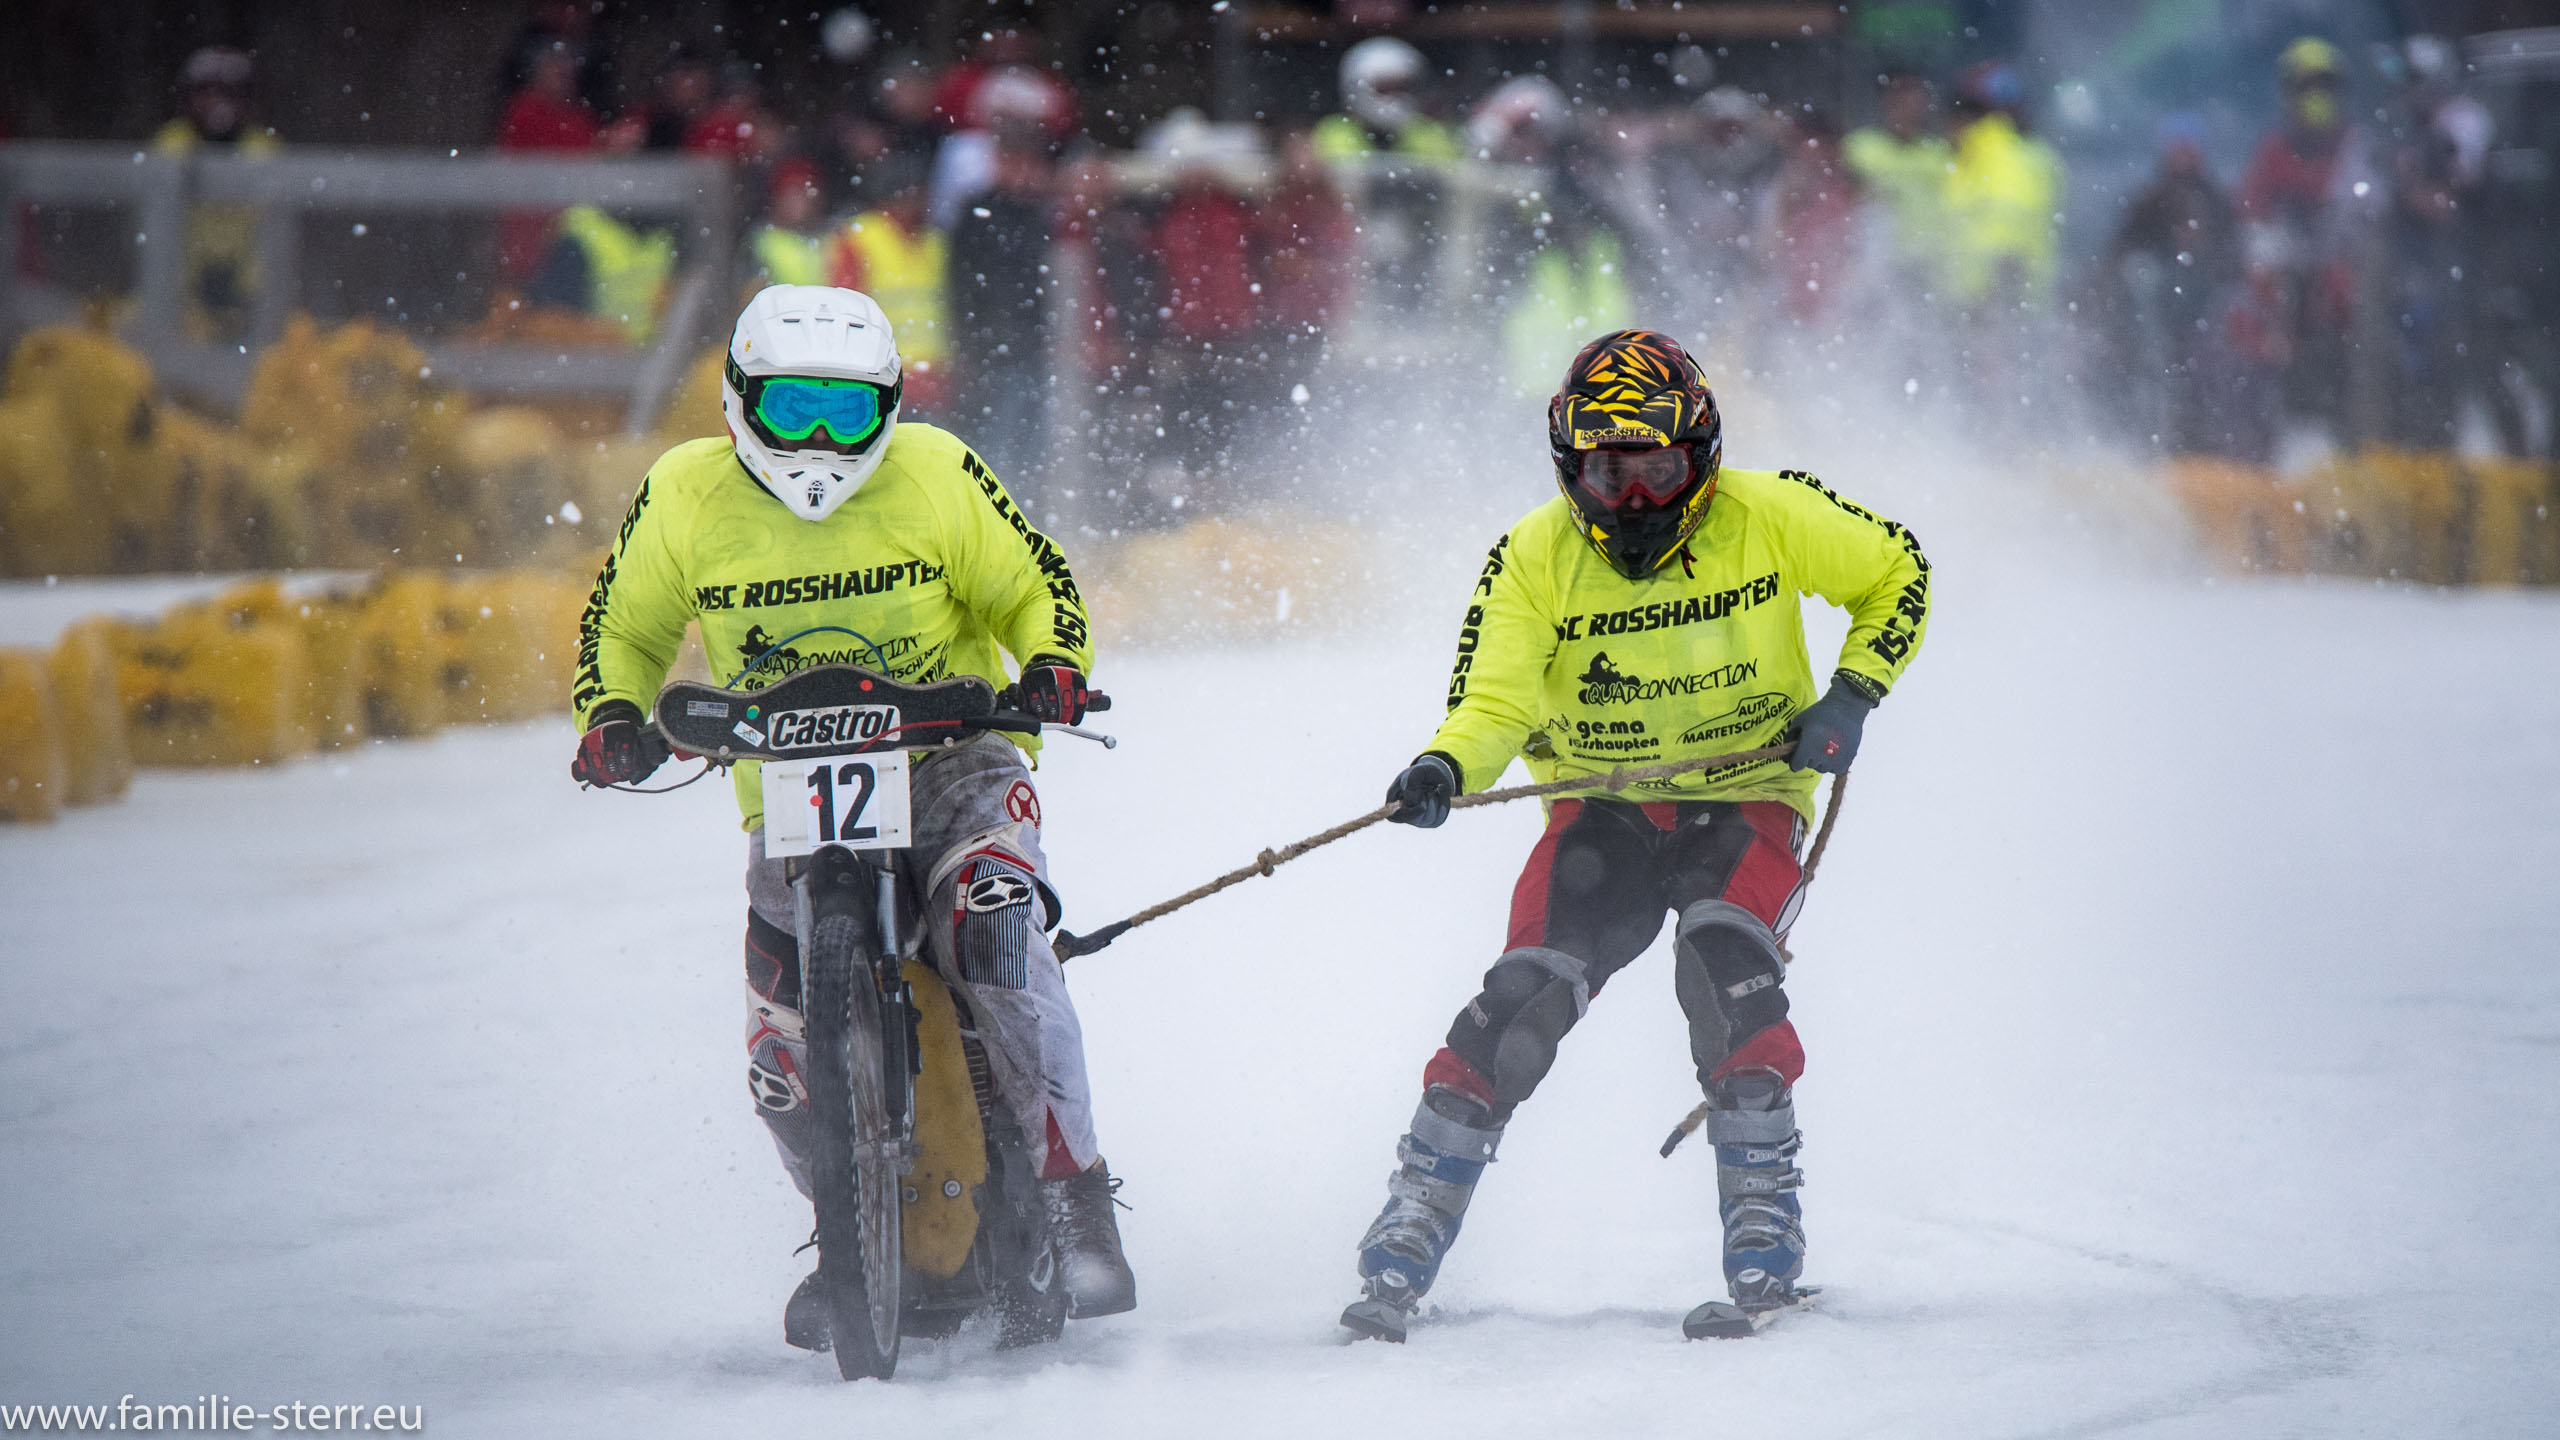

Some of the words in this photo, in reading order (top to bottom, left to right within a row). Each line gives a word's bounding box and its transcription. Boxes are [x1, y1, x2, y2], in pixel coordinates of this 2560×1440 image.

[1588, 572, 1779, 637] ROSSHAUPTEN
[1587, 658, 1758, 706] QUADCONNECTION
[770, 707, 895, 748] Castrol
[1576, 720, 1645, 739] ge.ma
[1682, 697, 1789, 744] MARTETSCHLÄGER
[1738, 696, 1769, 717] AUTO
[807, 762, 878, 842] 12
